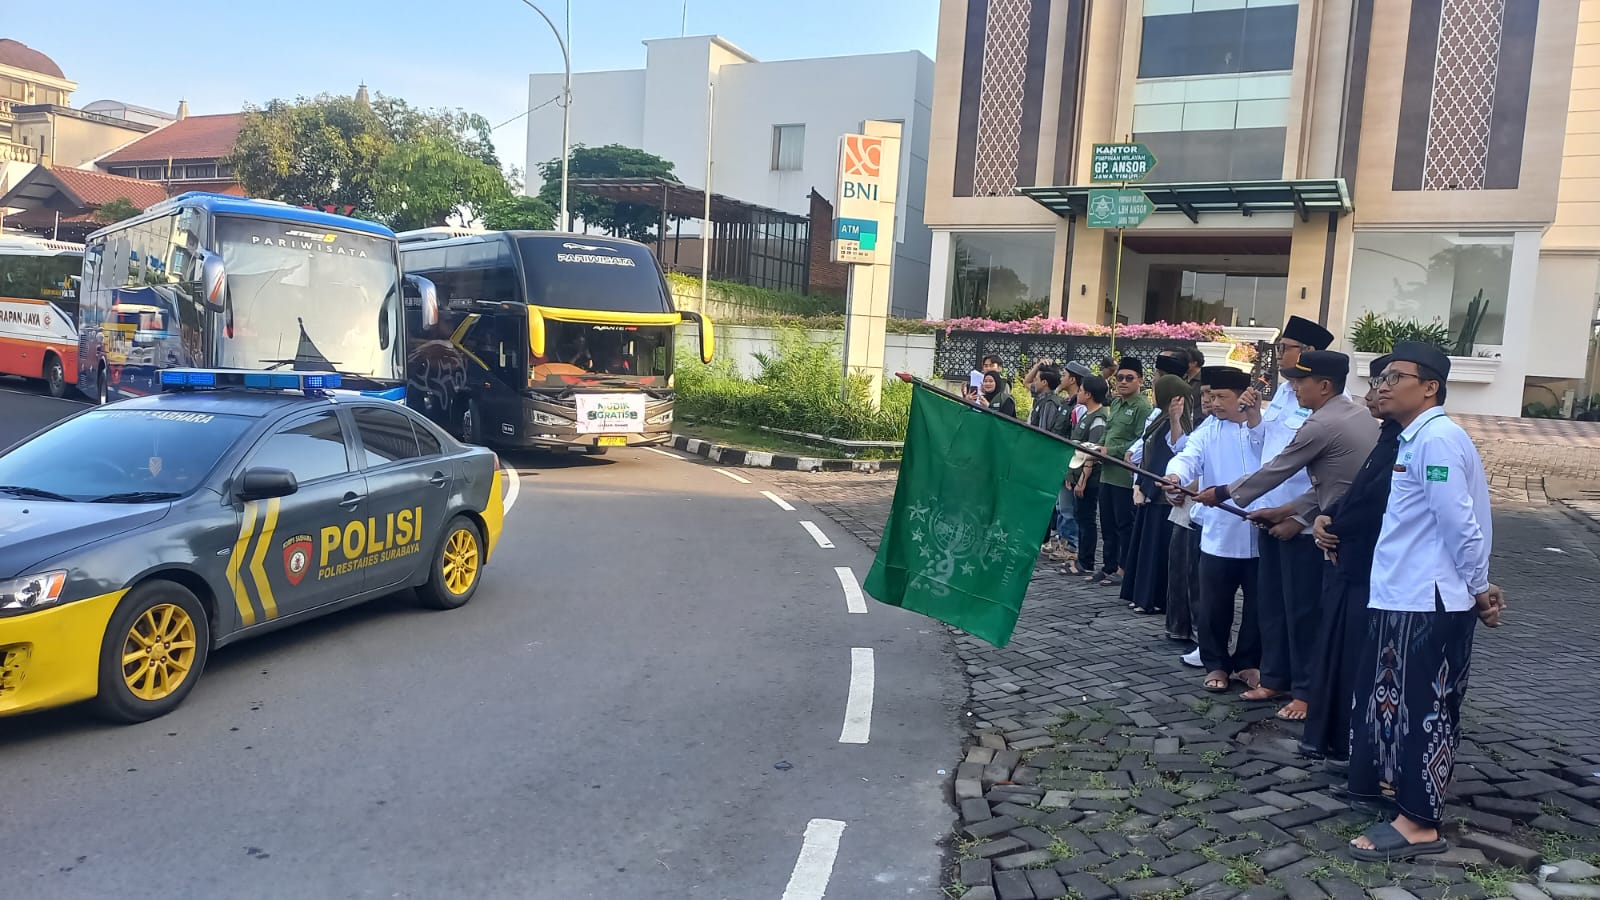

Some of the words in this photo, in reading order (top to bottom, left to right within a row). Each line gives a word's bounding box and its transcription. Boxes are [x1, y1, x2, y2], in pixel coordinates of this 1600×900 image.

[1095, 146, 1138, 154] KANTOR
[1094, 161, 1109, 173] GP.
[1112, 161, 1147, 173] ANSOR
[843, 181, 878, 201] BNI
[1118, 204, 1129, 214] LBH
[1129, 204, 1147, 214] ANSOR
[841, 224, 860, 234] ATM
[252, 236, 368, 258] PARIWISATA
[557, 253, 636, 267] PARIWISATA
[23, 312, 41, 327] JAYA
[597, 411, 630, 419] GRATIS
[319, 506, 423, 567] POLISI
[317, 553, 379, 581] POLRESTABES
[380, 542, 420, 563] SURABAYA
